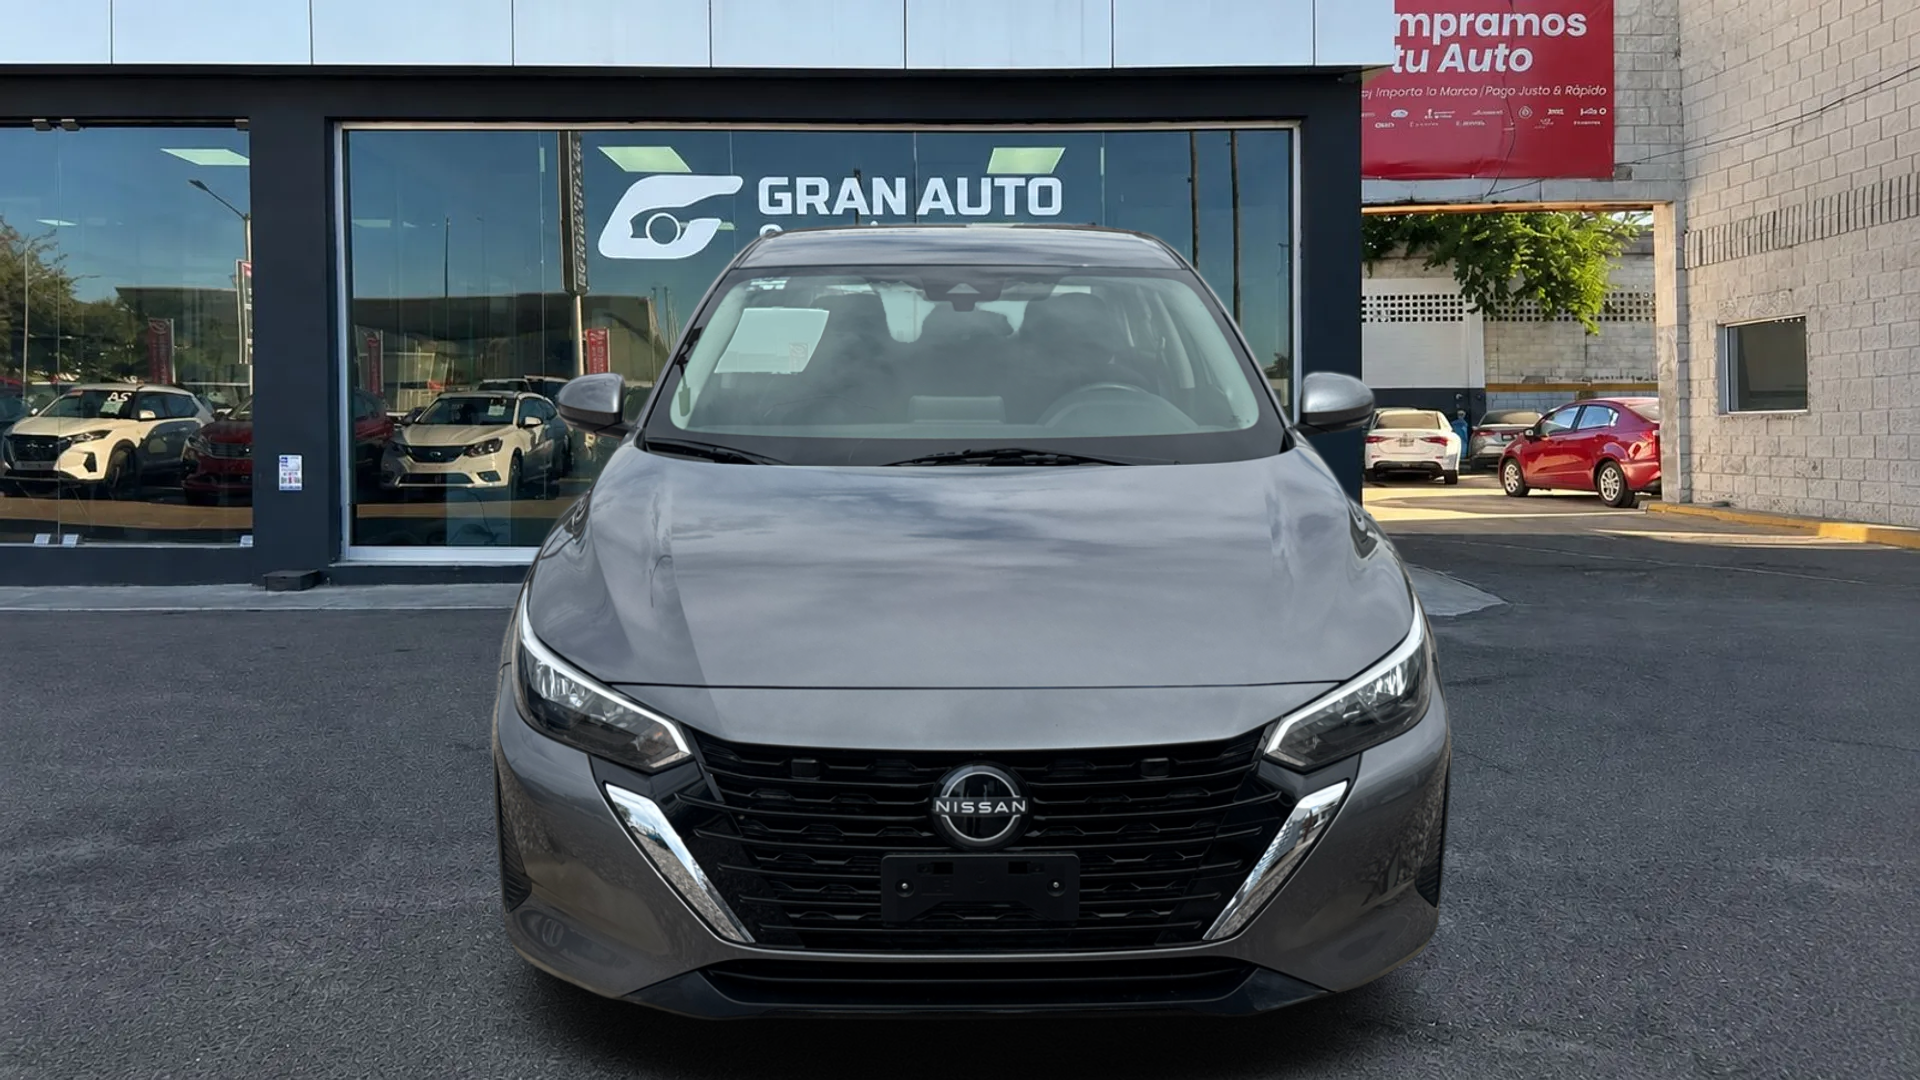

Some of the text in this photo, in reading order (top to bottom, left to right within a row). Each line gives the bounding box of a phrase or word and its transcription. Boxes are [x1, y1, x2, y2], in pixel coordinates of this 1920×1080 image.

[1392, 43, 1534, 73] tu Auto
[1375, 87, 1423, 100] Importa
[1425, 87, 1437, 96] la
[1439, 86, 1479, 97] Marca
[1518, 86, 1551, 96] Justo
[1552, 86, 1562, 96] &
[758, 176, 1063, 216] GRAN AUTO
[935, 800, 1026, 814] NISSAN
